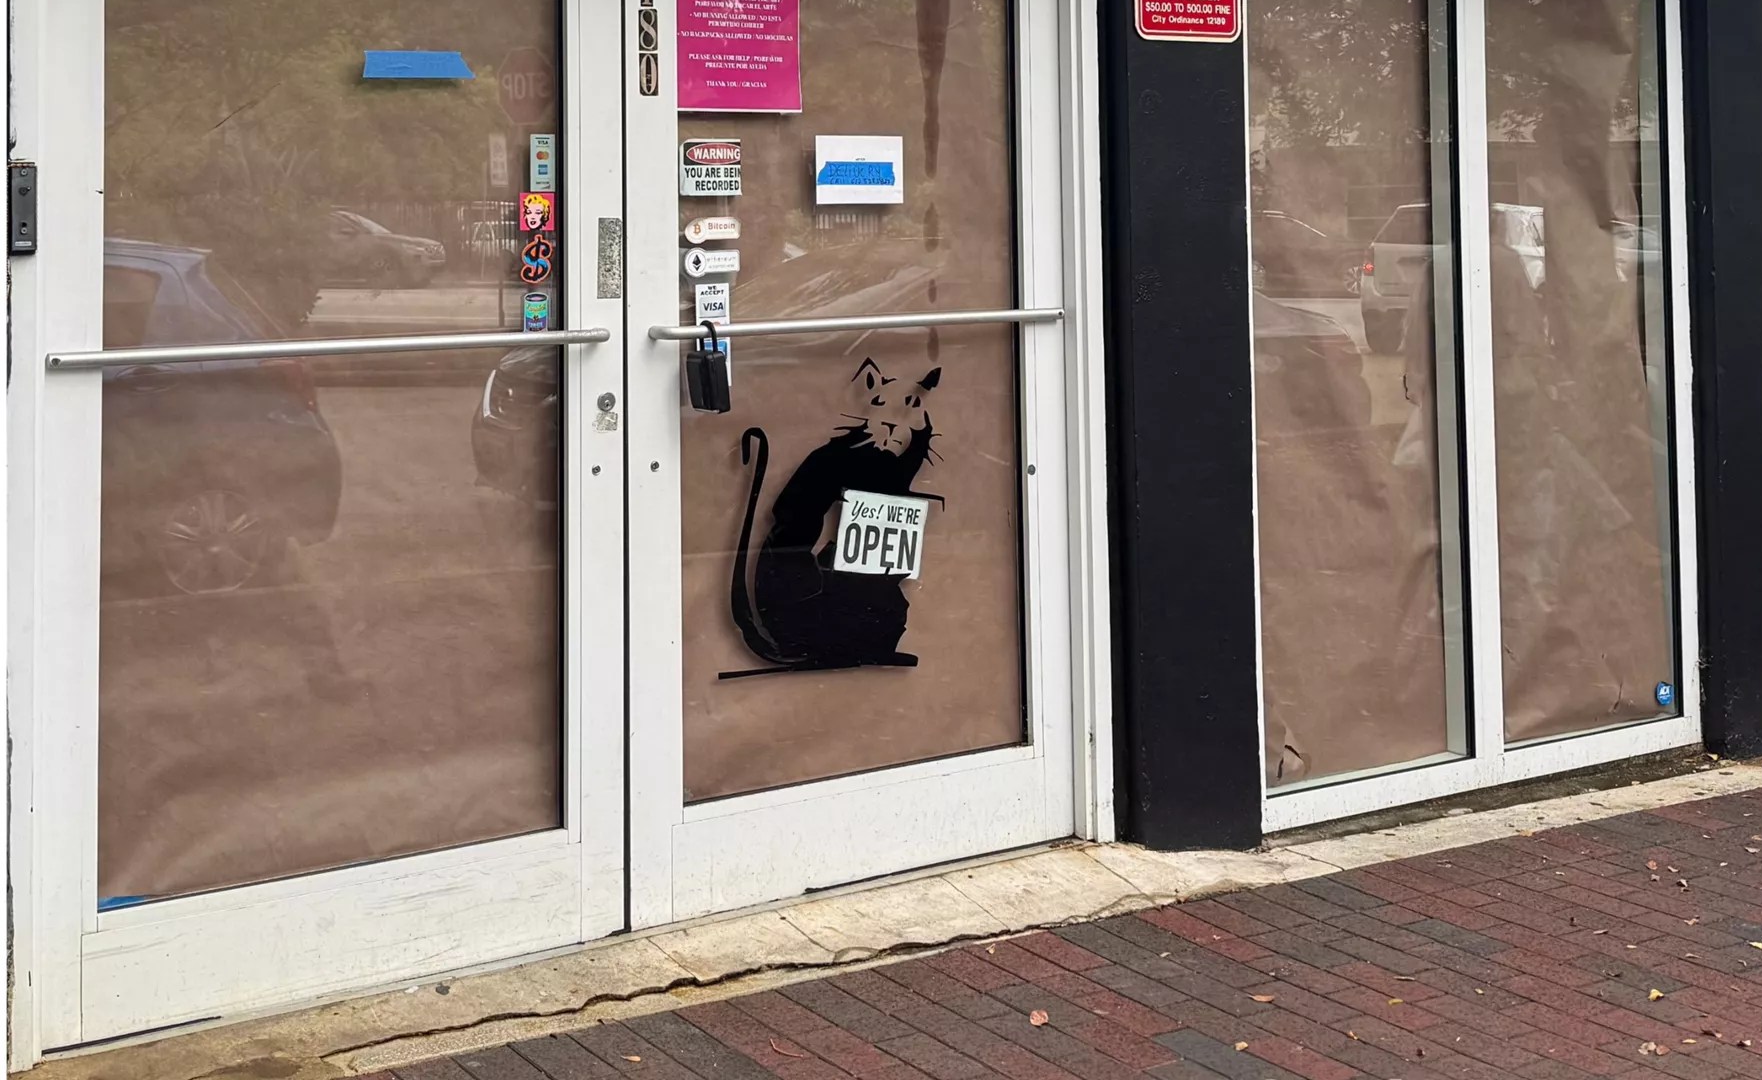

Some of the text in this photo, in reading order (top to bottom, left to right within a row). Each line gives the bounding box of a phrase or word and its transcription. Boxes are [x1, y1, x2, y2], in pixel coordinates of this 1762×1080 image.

[1145, 1, 1231, 15] $50.00 TO 500.00 FINE
[692, 11, 702, 19] NO
[759, 14, 768, 22] NO
[1151, 15, 1167, 24] City
[1168, 15, 1204, 25] Ordinance
[689, 30, 724, 39] BACKPACKS
[688, 53, 711, 61] PLEASE
[706, 80, 726, 88] THANK
[693, 148, 741, 160] WARNING
[684, 167, 703, 178] YOU
[704, 167, 721, 178] ARE
[695, 180, 740, 191] RECORDED
[707, 222, 736, 230] Bitcoin
[703, 301, 724, 312] VISA
[851, 500, 921, 525] Yes! WE'RE
[842, 522, 918, 571] OPEN
